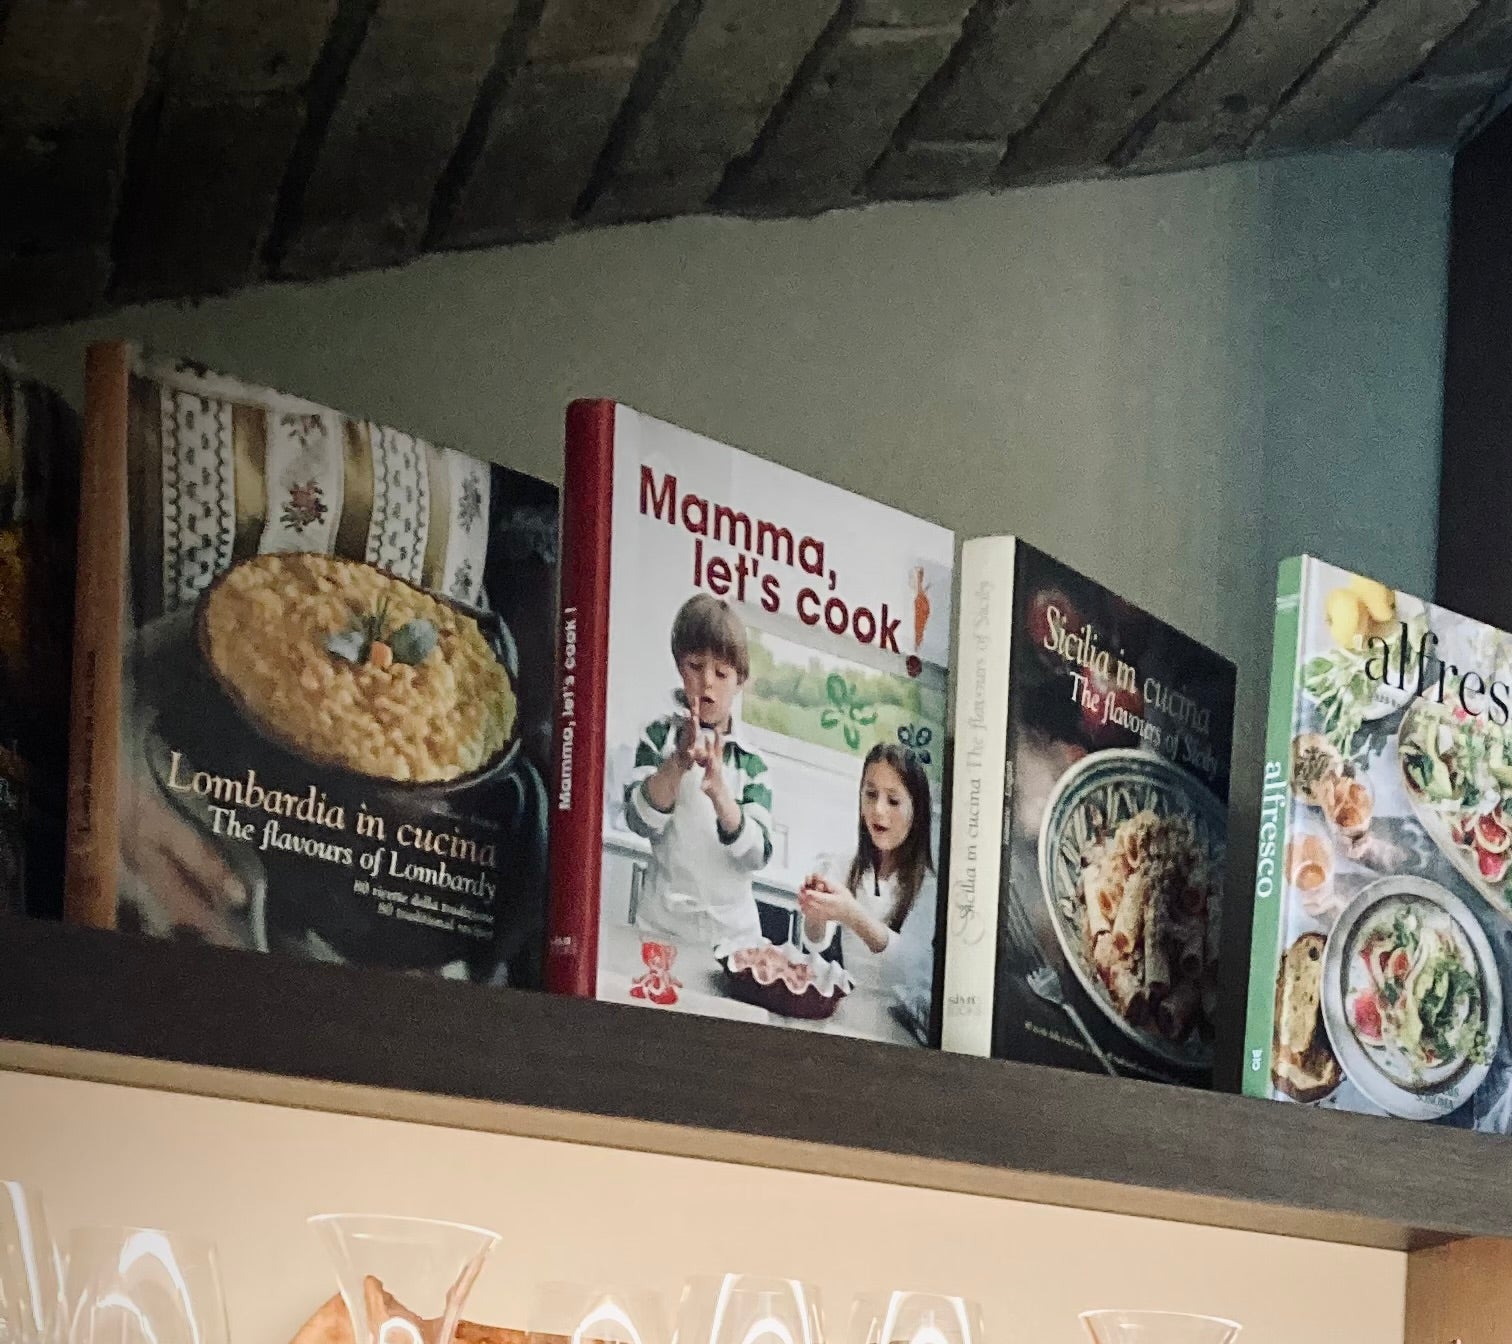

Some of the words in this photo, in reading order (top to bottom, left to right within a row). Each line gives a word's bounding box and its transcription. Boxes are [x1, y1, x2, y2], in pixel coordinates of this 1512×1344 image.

[639, 464, 837, 591] Mamma,
[693, 538, 780, 613] let's
[1043, 605, 1109, 681] Sicilia
[1117, 649, 1138, 695] in
[1069, 670, 1099, 713] The
[1101, 690, 1162, 748] flavours
[166, 750, 345, 831] Lombardia
[356, 800, 385, 842] in
[396, 822, 497, 869] cucina
[207, 803, 256, 841] The
[258, 819, 353, 866] flavours
[359, 848, 386, 877] of
[388, 850, 496, 902] Lombardy
[1256, 760, 1287, 898] alfresco
